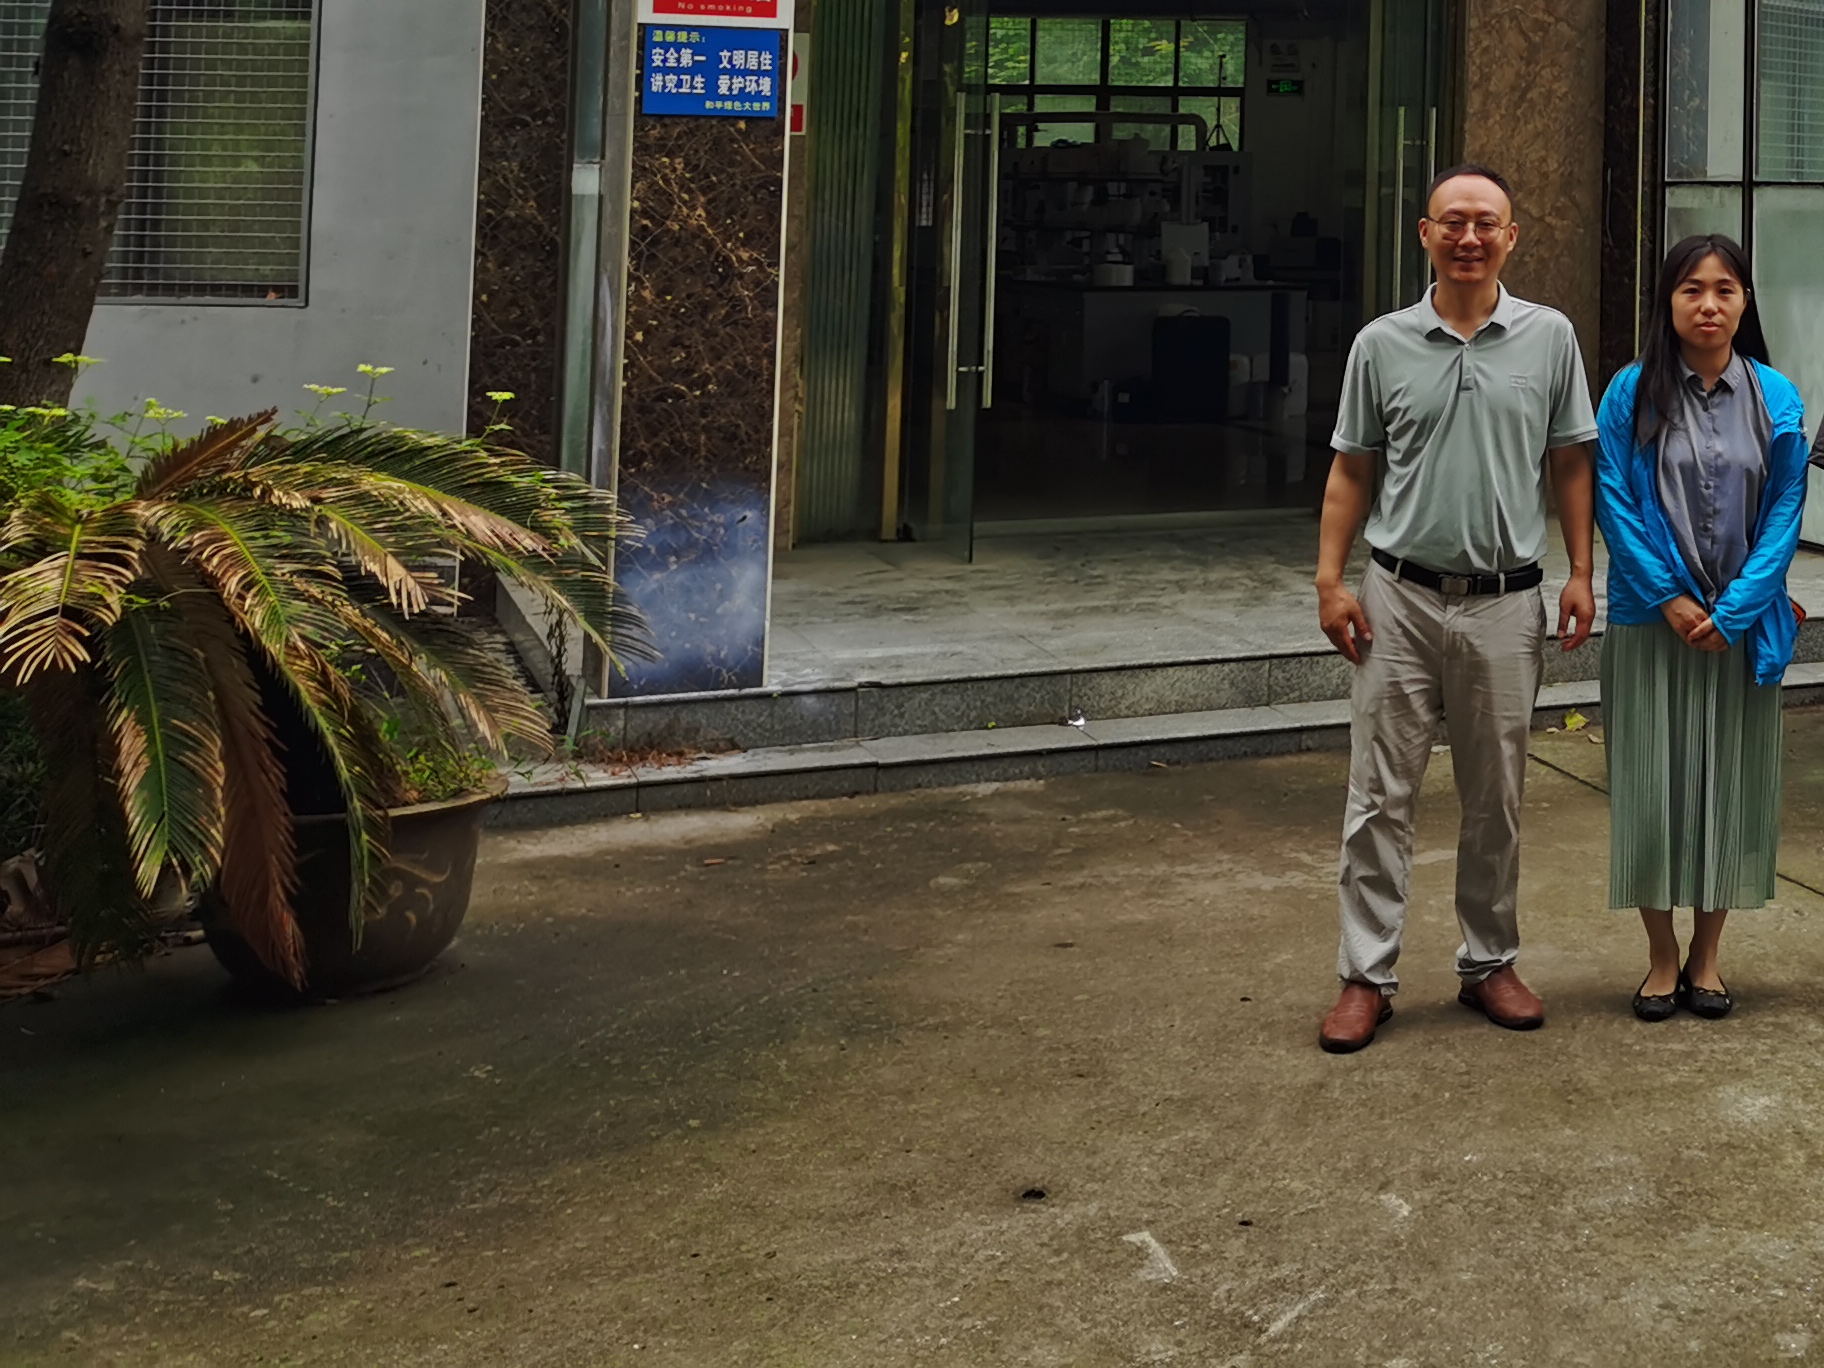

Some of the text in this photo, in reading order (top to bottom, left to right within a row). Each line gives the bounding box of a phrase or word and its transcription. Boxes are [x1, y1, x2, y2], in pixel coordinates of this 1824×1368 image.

[678, 2, 753, 14] No smoking
[651, 47, 773, 71] 安全第一 文明居住
[650, 72, 772, 96] 讲究卫生 爱护环境
